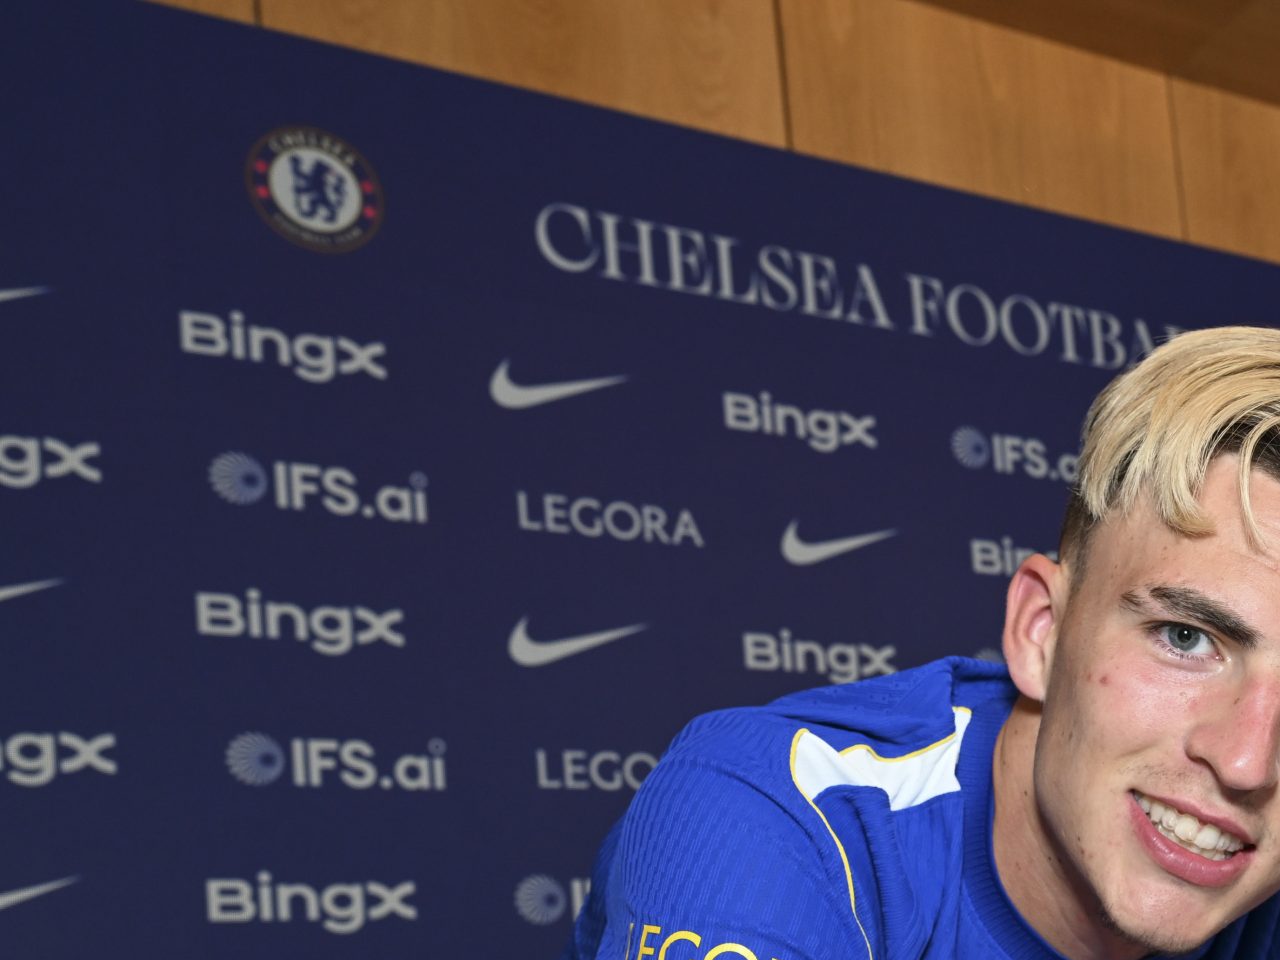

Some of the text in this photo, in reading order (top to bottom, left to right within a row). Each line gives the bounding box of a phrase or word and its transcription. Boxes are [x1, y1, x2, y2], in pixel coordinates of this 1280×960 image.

[535, 203, 1182, 373] CHELSEA FOOTBA
[274, 461, 429, 523] IFS.ai
[517, 491, 704, 547] LEGORA
[0, 732, 117, 787] gx
[291, 738, 446, 790] IFS.ai
